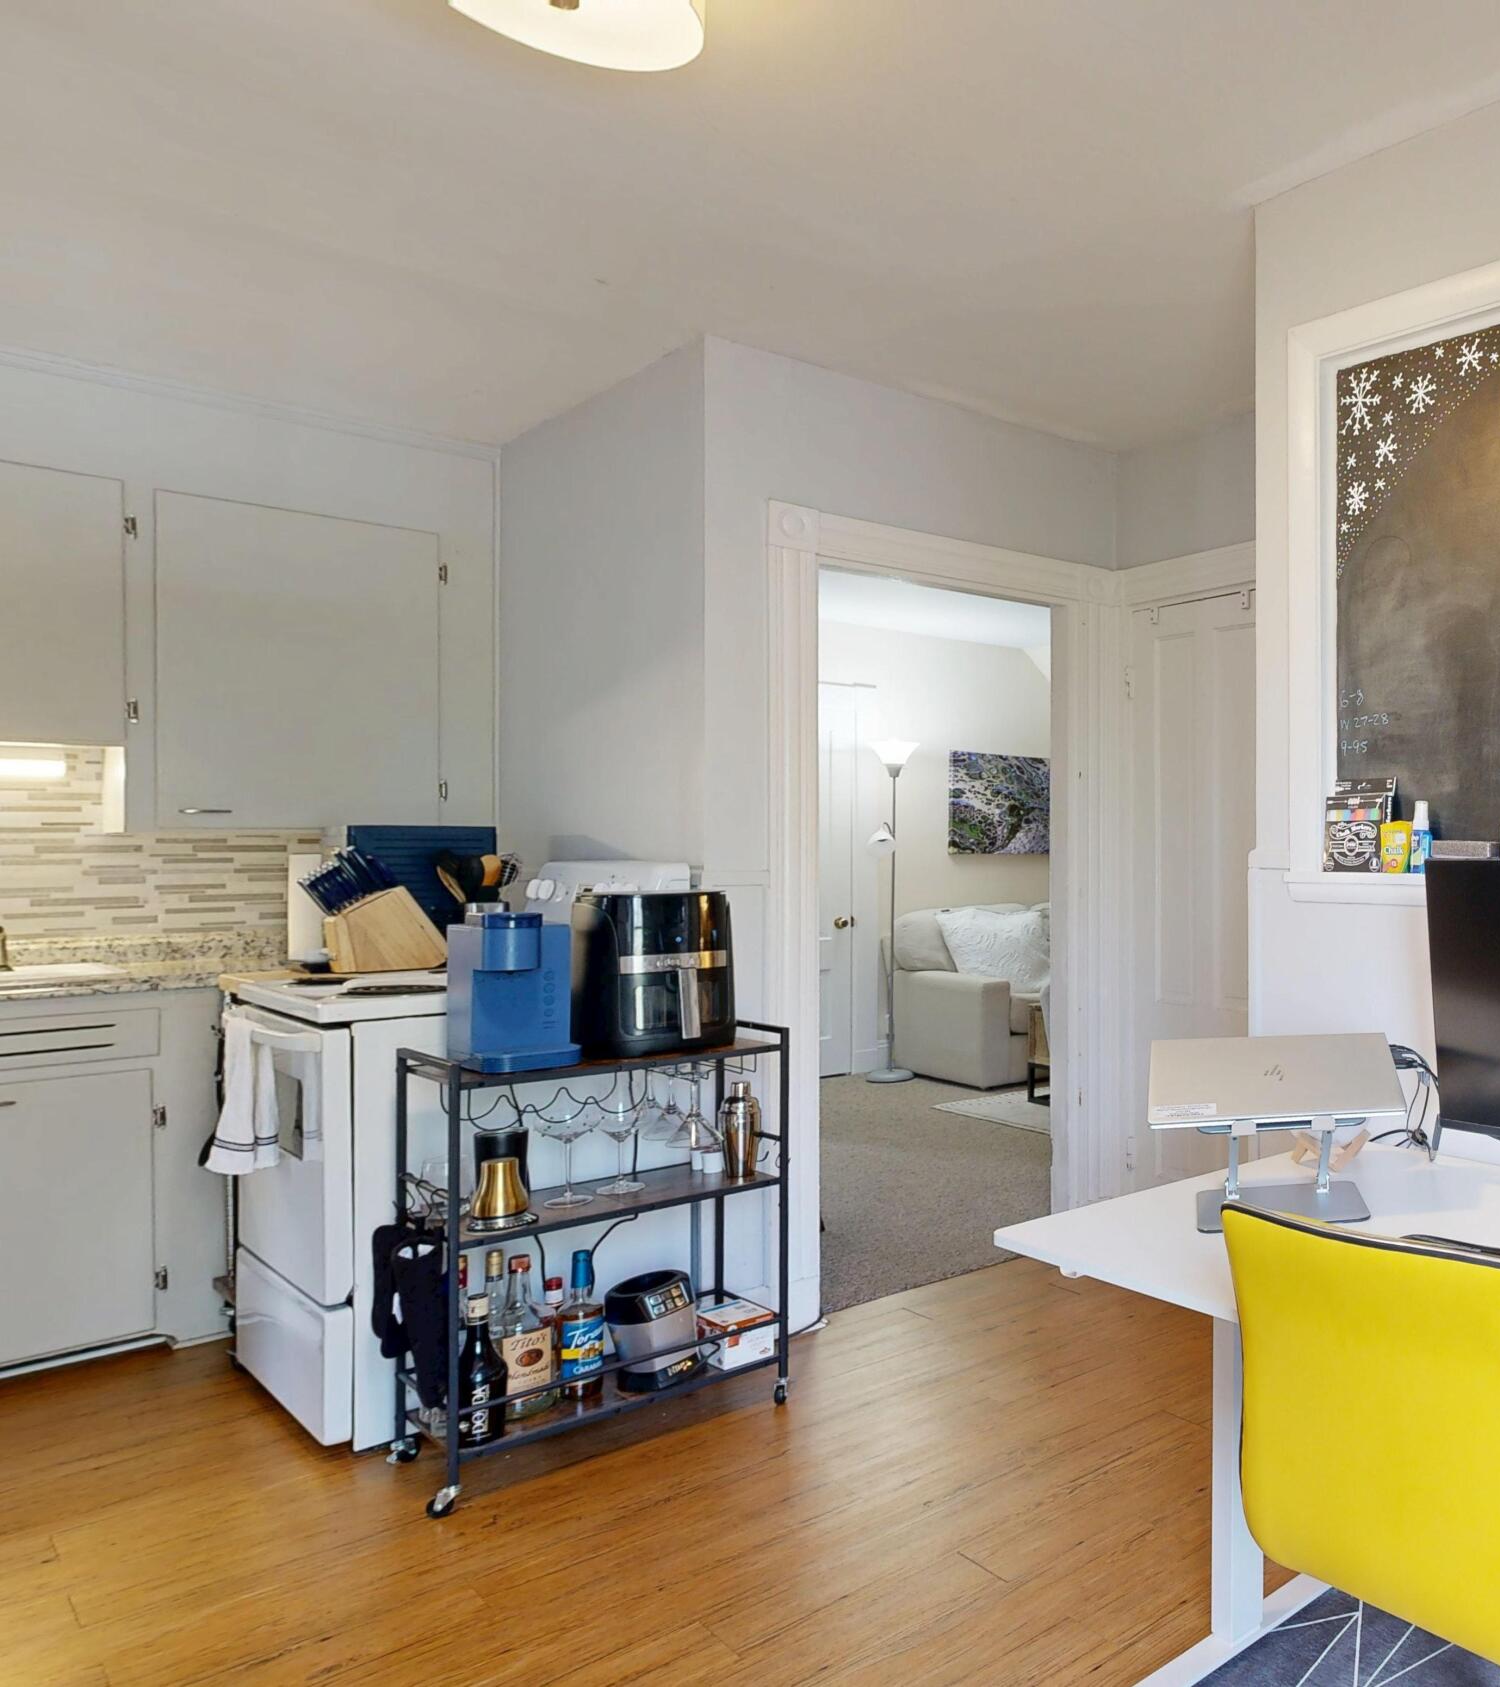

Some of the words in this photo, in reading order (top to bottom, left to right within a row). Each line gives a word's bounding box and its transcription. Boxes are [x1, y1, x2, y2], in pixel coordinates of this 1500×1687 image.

[1353, 712, 1389, 728] 27-28
[1340, 739, 1368, 756] 9-95
[1384, 846, 1404, 855] Chalk
[510, 1332, 547, 1351] Tito's
